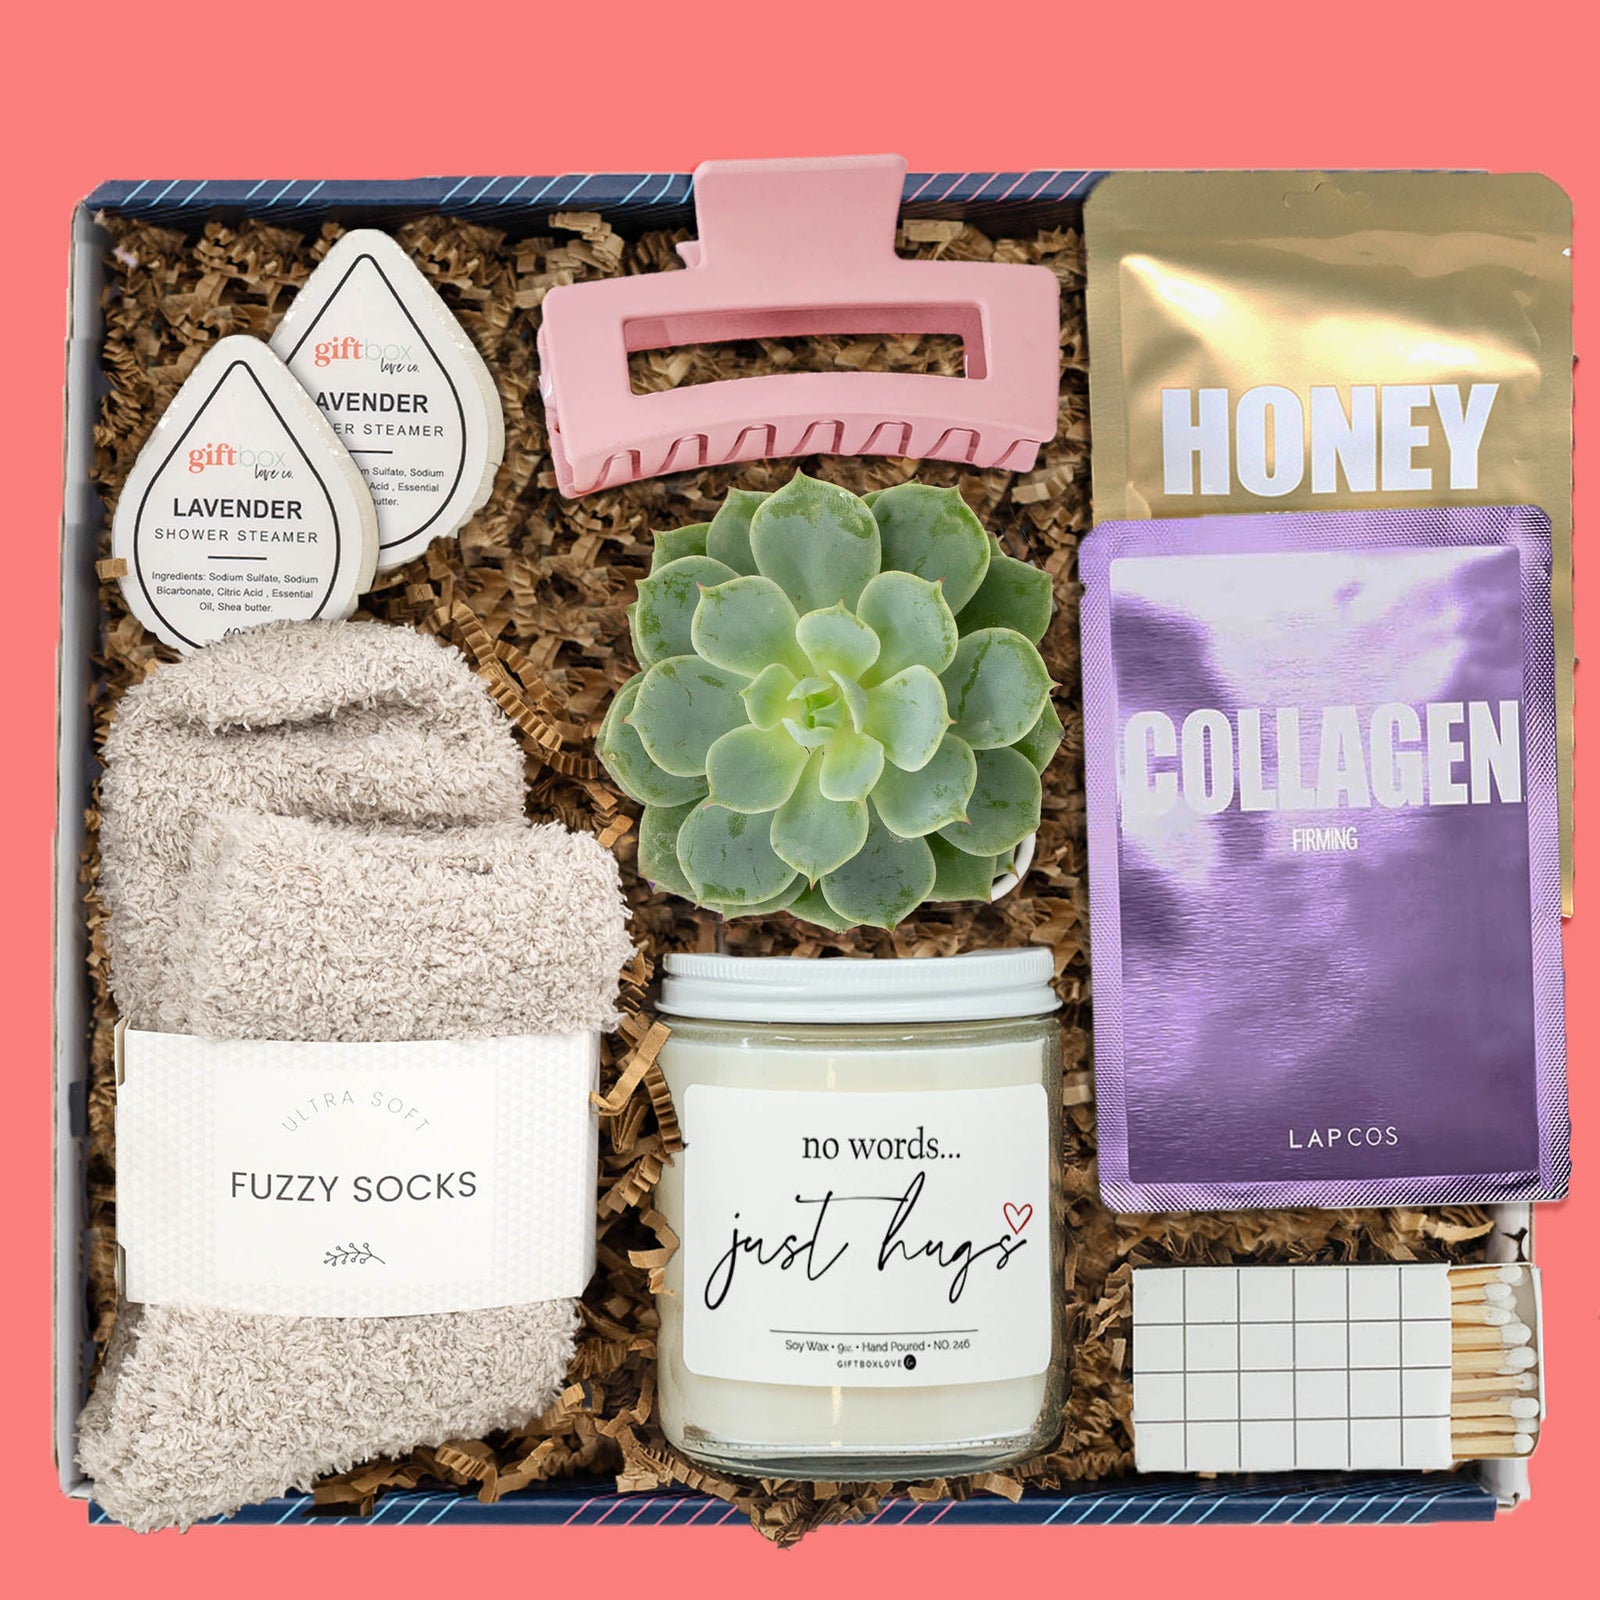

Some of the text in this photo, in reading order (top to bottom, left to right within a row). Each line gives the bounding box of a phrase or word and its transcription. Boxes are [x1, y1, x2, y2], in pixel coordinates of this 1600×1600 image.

[380, 358, 406, 375] love
[316, 392, 429, 413] AVENDER
[363, 423, 444, 437] STEAMER
[1161, 383, 1500, 496] HONEY
[254, 463, 280, 481] love
[409, 468, 445, 478] Sodium
[397, 483, 440, 493] Essential
[173, 497, 303, 520] LAVENDER
[154, 528, 319, 544] SHOWER STEAMER
[151, 571, 319, 584] Ingredients: Sodium Sulfate, Sodium
[156, 586, 214, 597] Bicarbonate,
[217, 587, 242, 597] Citric
[272, 589, 314, 599] Essential
[199, 602, 273, 613] Oil, Shea butter.
[1122, 700, 1522, 816] COLLAGEN
[1292, 826, 1359, 852] FIRMING
[281, 1089, 431, 1132] ULTRA SOFT
[801, 1126, 962, 1161] no words...
[1288, 1126, 1399, 1149] LAPCOS
[230, 1170, 478, 1202] FUZZY SOCKS
[877, 1171, 1027, 1304] hugs
[785, 1339, 804, 1353] Soy
[805, 1341, 829, 1352] Wax
[862, 1342, 889, 1352] Hand
[890, 1341, 926, 1352] Poured
[952, 1338, 971, 1349] 246
[836, 1359, 903, 1369] GIFTBOXLOVE
